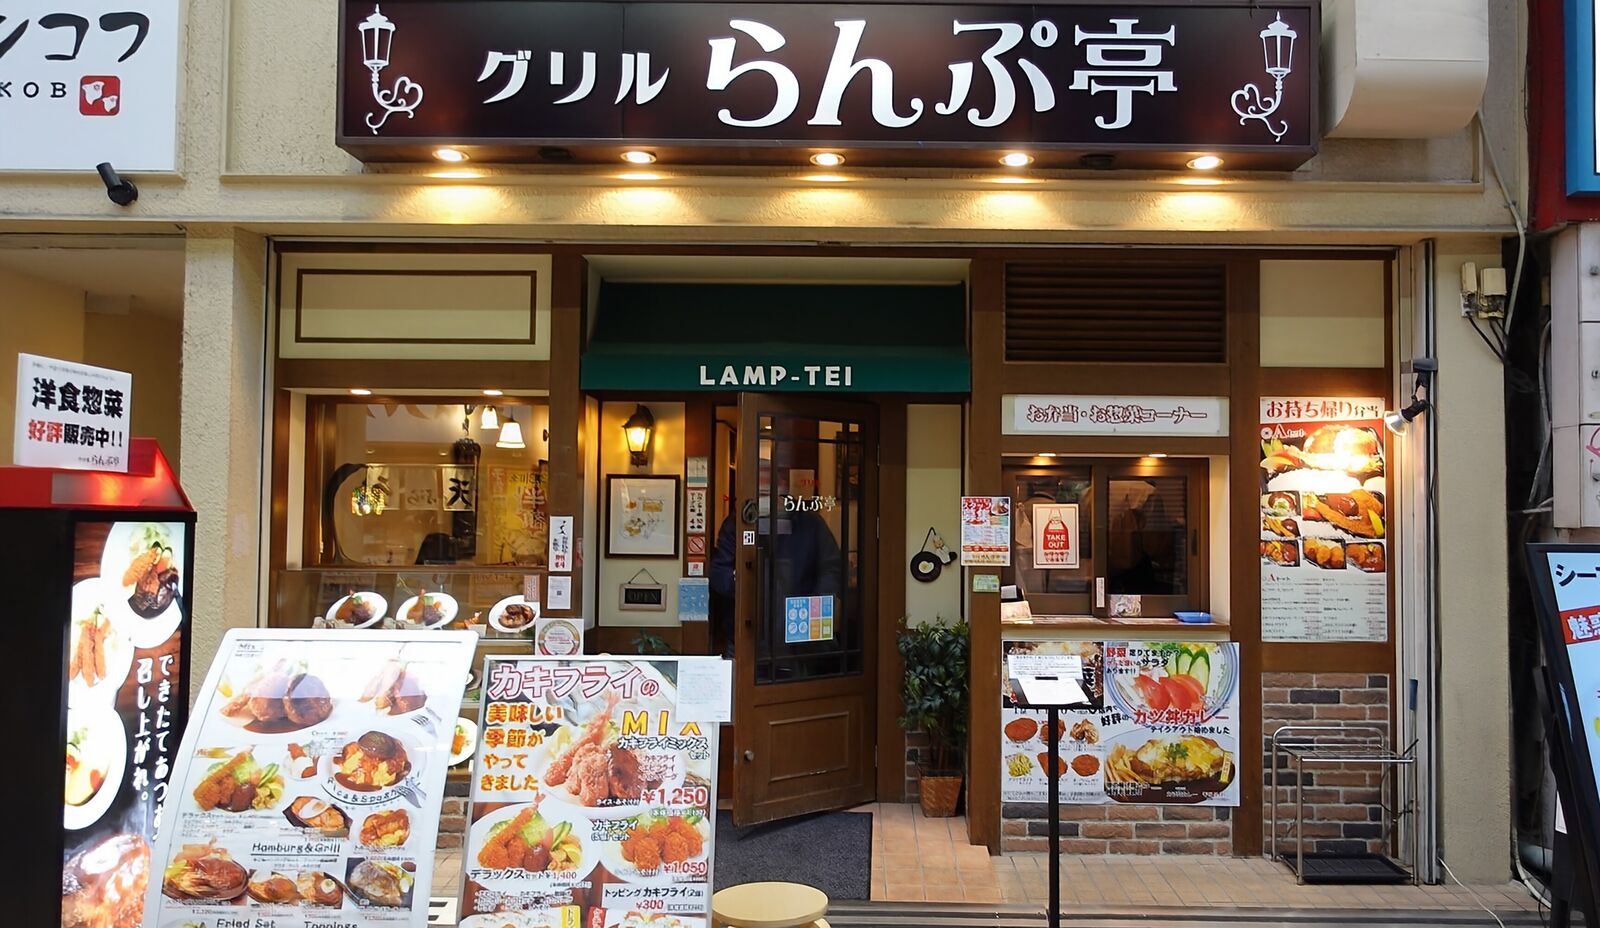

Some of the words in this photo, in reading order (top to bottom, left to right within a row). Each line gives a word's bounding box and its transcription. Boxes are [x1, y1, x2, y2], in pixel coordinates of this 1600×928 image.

[477, 50, 670, 105] グリル
[706, 19, 1178, 129] らんぷ亭
[700, 365, 852, 386] LAMP-TEI
[32, 377, 124, 418] 洋食惣菜
[1027, 404, 1208, 424] お弁当・お惣菜コーナー
[783, 495, 837, 512] らんぷ亭
[1555, 563, 1600, 588] シー
[489, 664, 660, 699] カキフライの
[486, 703, 564, 724] 美味しい
[152, 654, 174, 842] できたてあつあ
[485, 727, 544, 748] 季節が
[618, 737, 708, 750] カキフライミックス
[483, 753, 529, 769] やって
[480, 773, 539, 792] きました
[642, 786, 708, 806] ¥1,250
[591, 819, 638, 831] カキフライ
